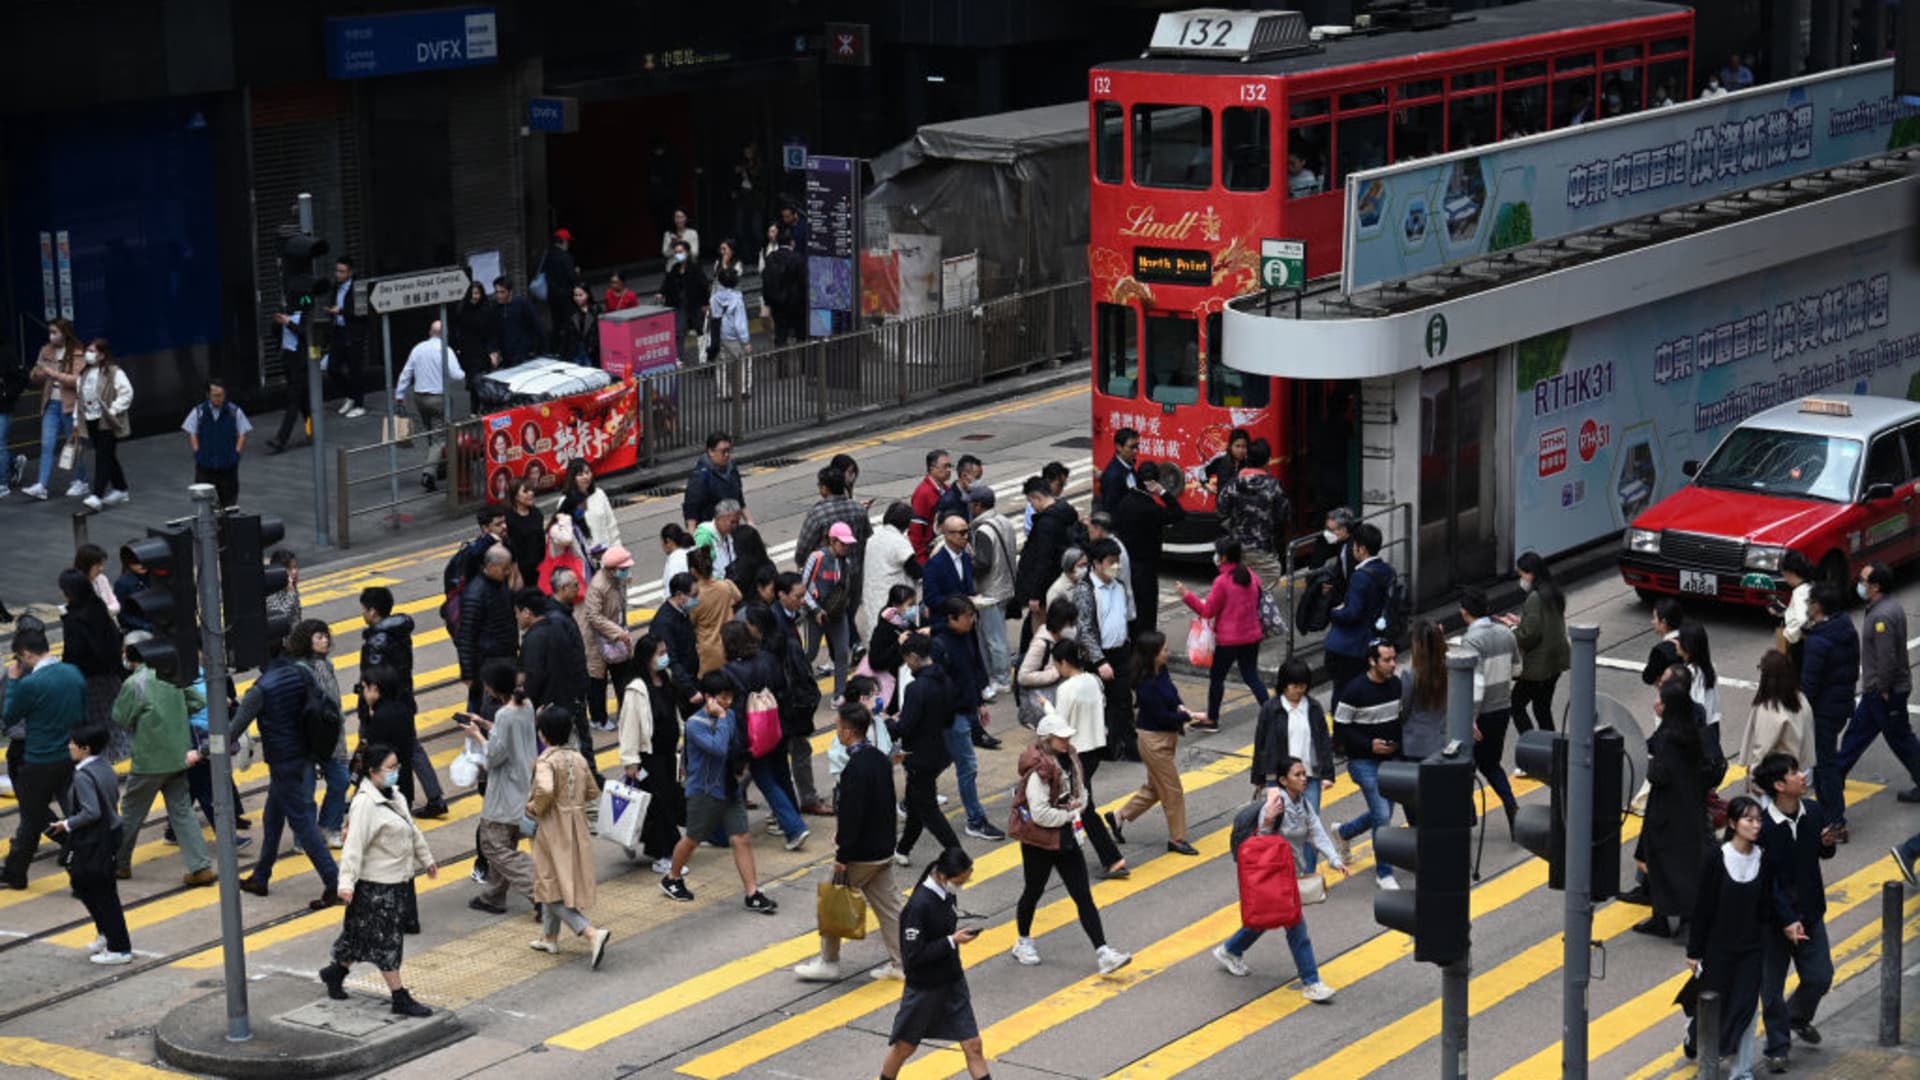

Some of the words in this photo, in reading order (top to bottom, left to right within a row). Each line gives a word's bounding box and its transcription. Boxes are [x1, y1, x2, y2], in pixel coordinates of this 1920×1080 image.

[1178, 18, 1234, 48] 132
[416, 40, 463, 63] DVFX
[1094, 77, 1111, 94] 132
[1240, 83, 1266, 101] 132
[1567, 160, 1608, 208] 中東
[1120, 206, 1199, 240] Lindt
[1177, 258, 1208, 273] Point
[1654, 336, 1693, 384] 中東
[1535, 360, 1614, 416] RTHK31
